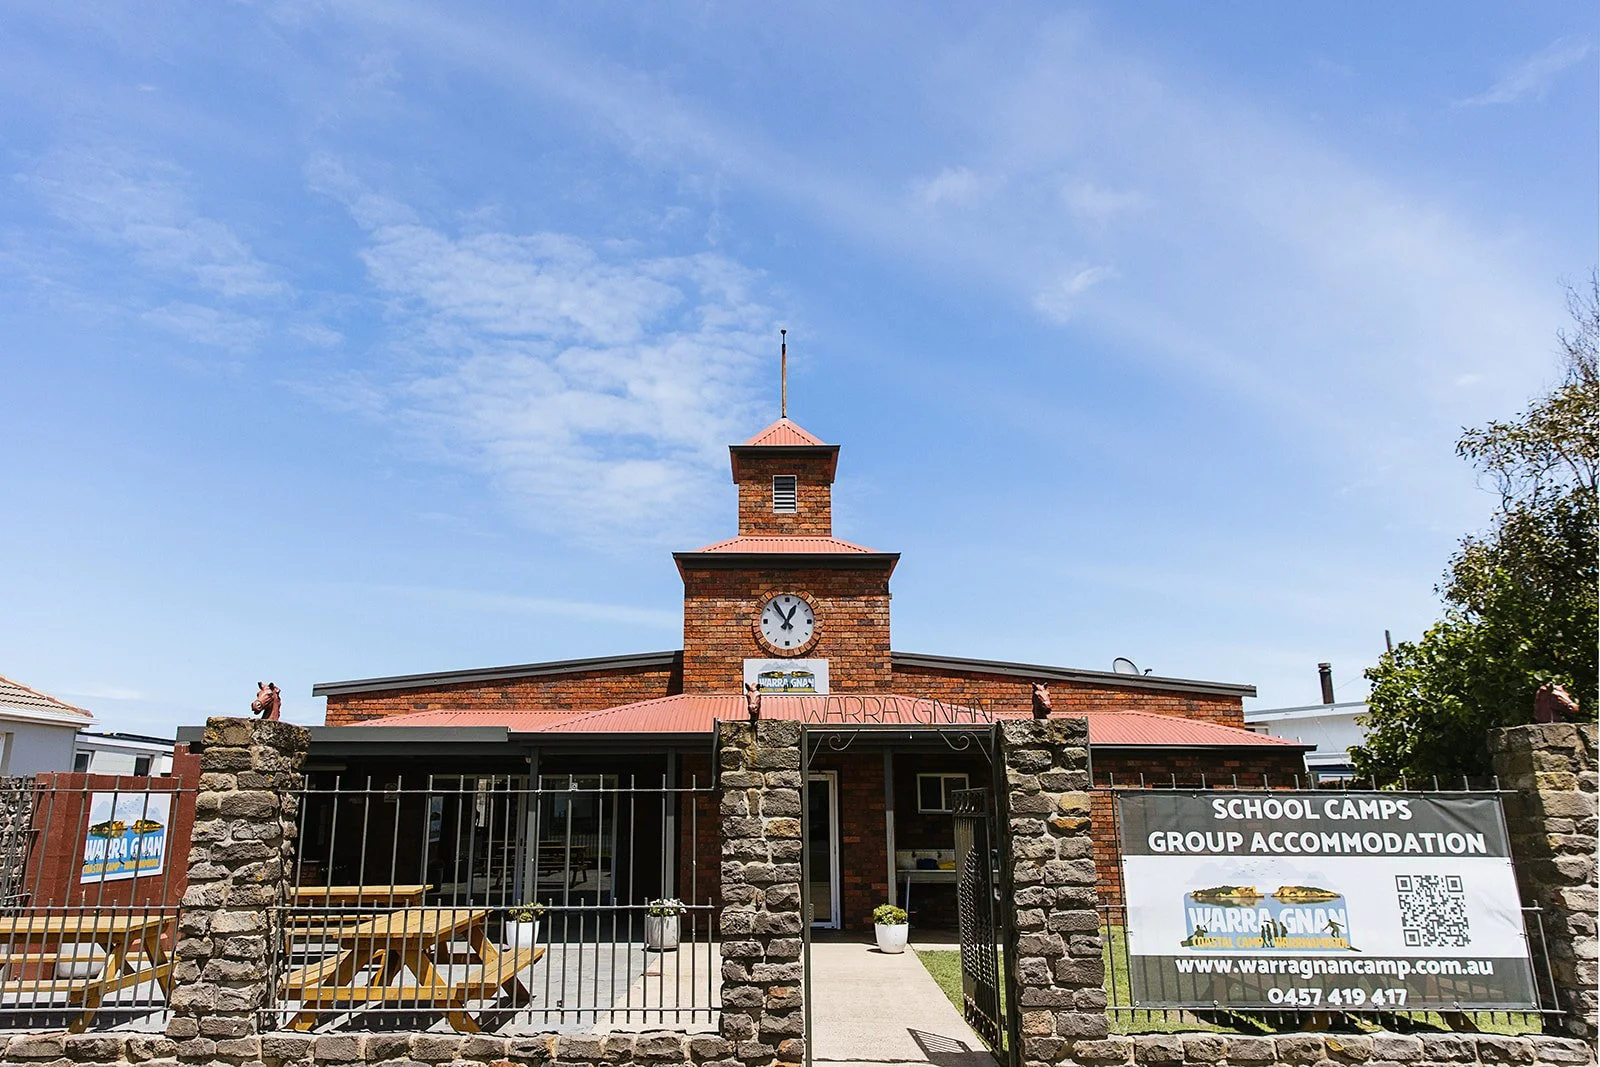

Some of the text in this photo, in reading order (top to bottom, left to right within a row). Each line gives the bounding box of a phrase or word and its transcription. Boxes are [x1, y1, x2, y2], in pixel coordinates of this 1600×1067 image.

[758, 678, 788, 687] WARRA
[800, 697, 993, 724] WARRA GNAN
[1213, 798, 1413, 820] SCHOOL CAMPS
[1148, 831, 1487, 854] GROUP ACCOMMODATION
[1188, 907, 1348, 934] WARRA GNAN
[1236, 936, 1264, 949] CAMP
[1175, 959, 1494, 979] www.warragnancamp.com.au
[1268, 988, 1407, 1006] 0457 419 417
